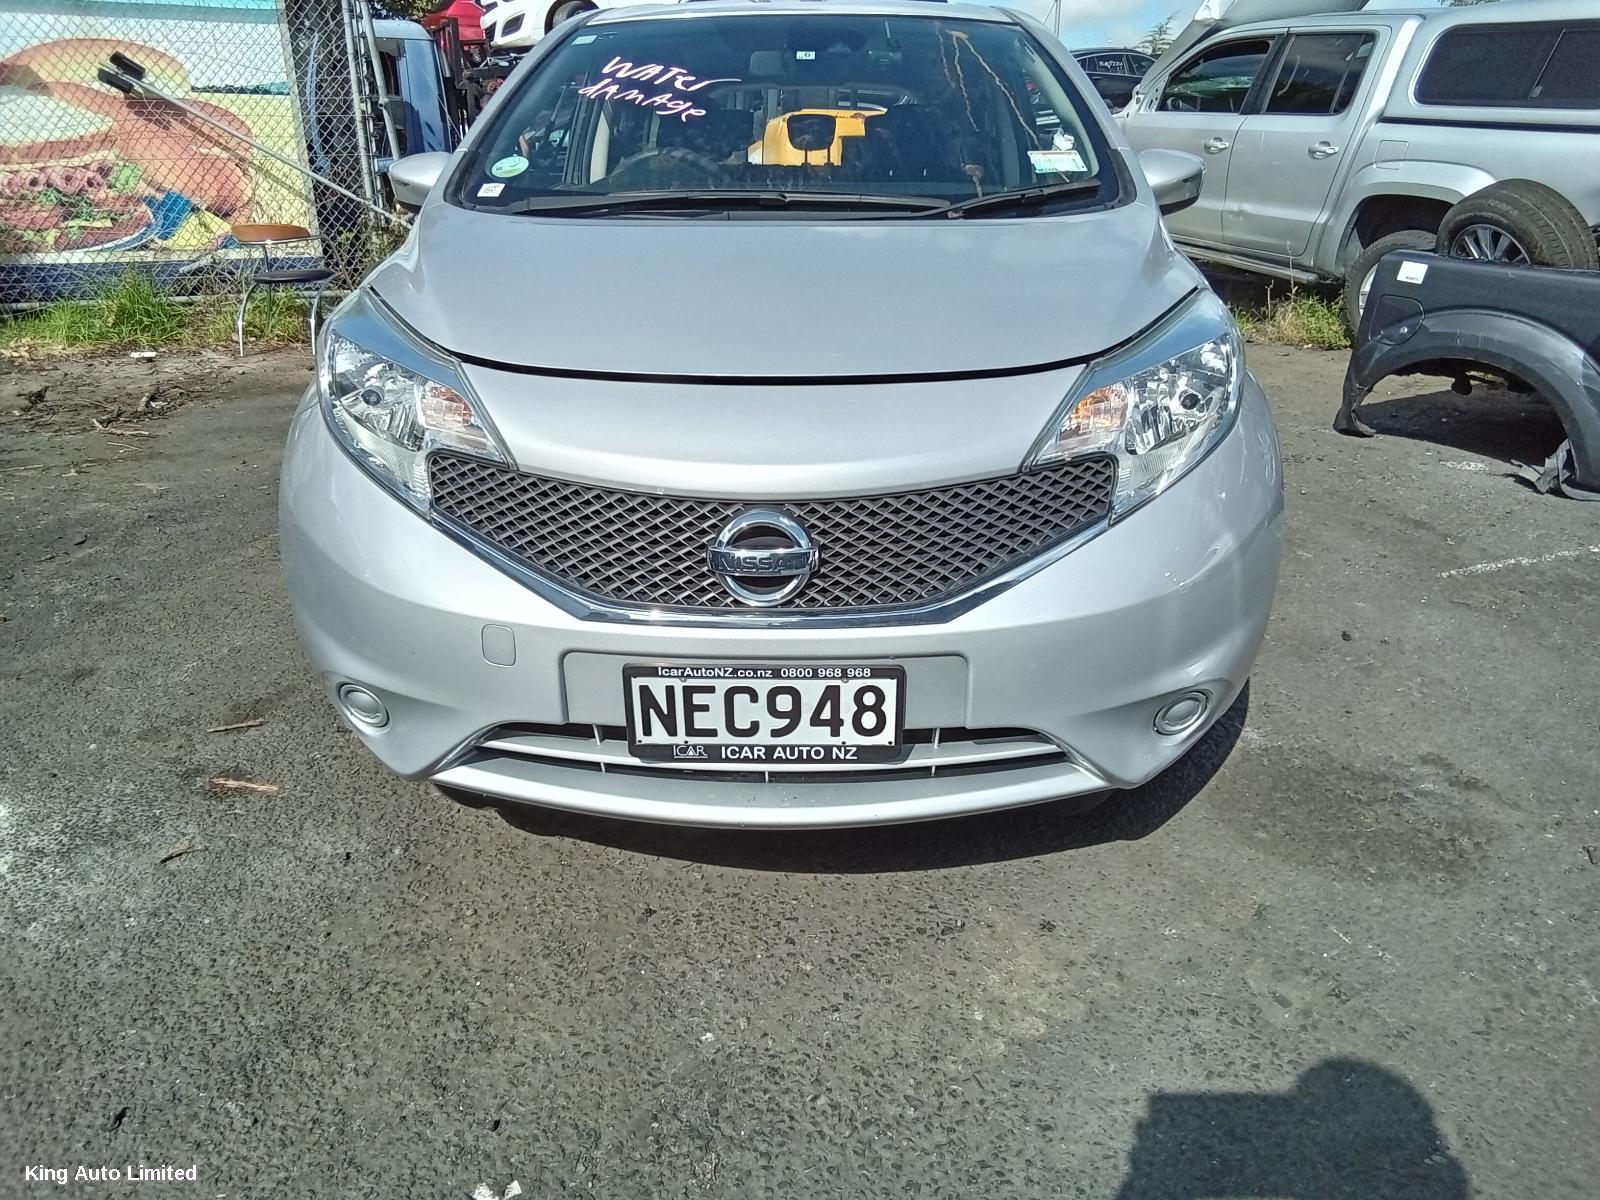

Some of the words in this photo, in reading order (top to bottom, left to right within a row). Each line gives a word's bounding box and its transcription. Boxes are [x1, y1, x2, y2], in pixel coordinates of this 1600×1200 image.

[715, 551, 809, 572] NISSAN
[657, 666, 773, 678] IcarAutoNZ.co.nz
[780, 668, 813, 678] 0800
[817, 668, 842, 678] 968
[846, 668, 871, 678] 968
[638, 684, 887, 738] NEC948
[673, 744, 709, 758] ICAR
[721, 746, 766, 760] ICAR
[772, 746, 825, 760] AUTO
[831, 746, 858, 760] NZ
